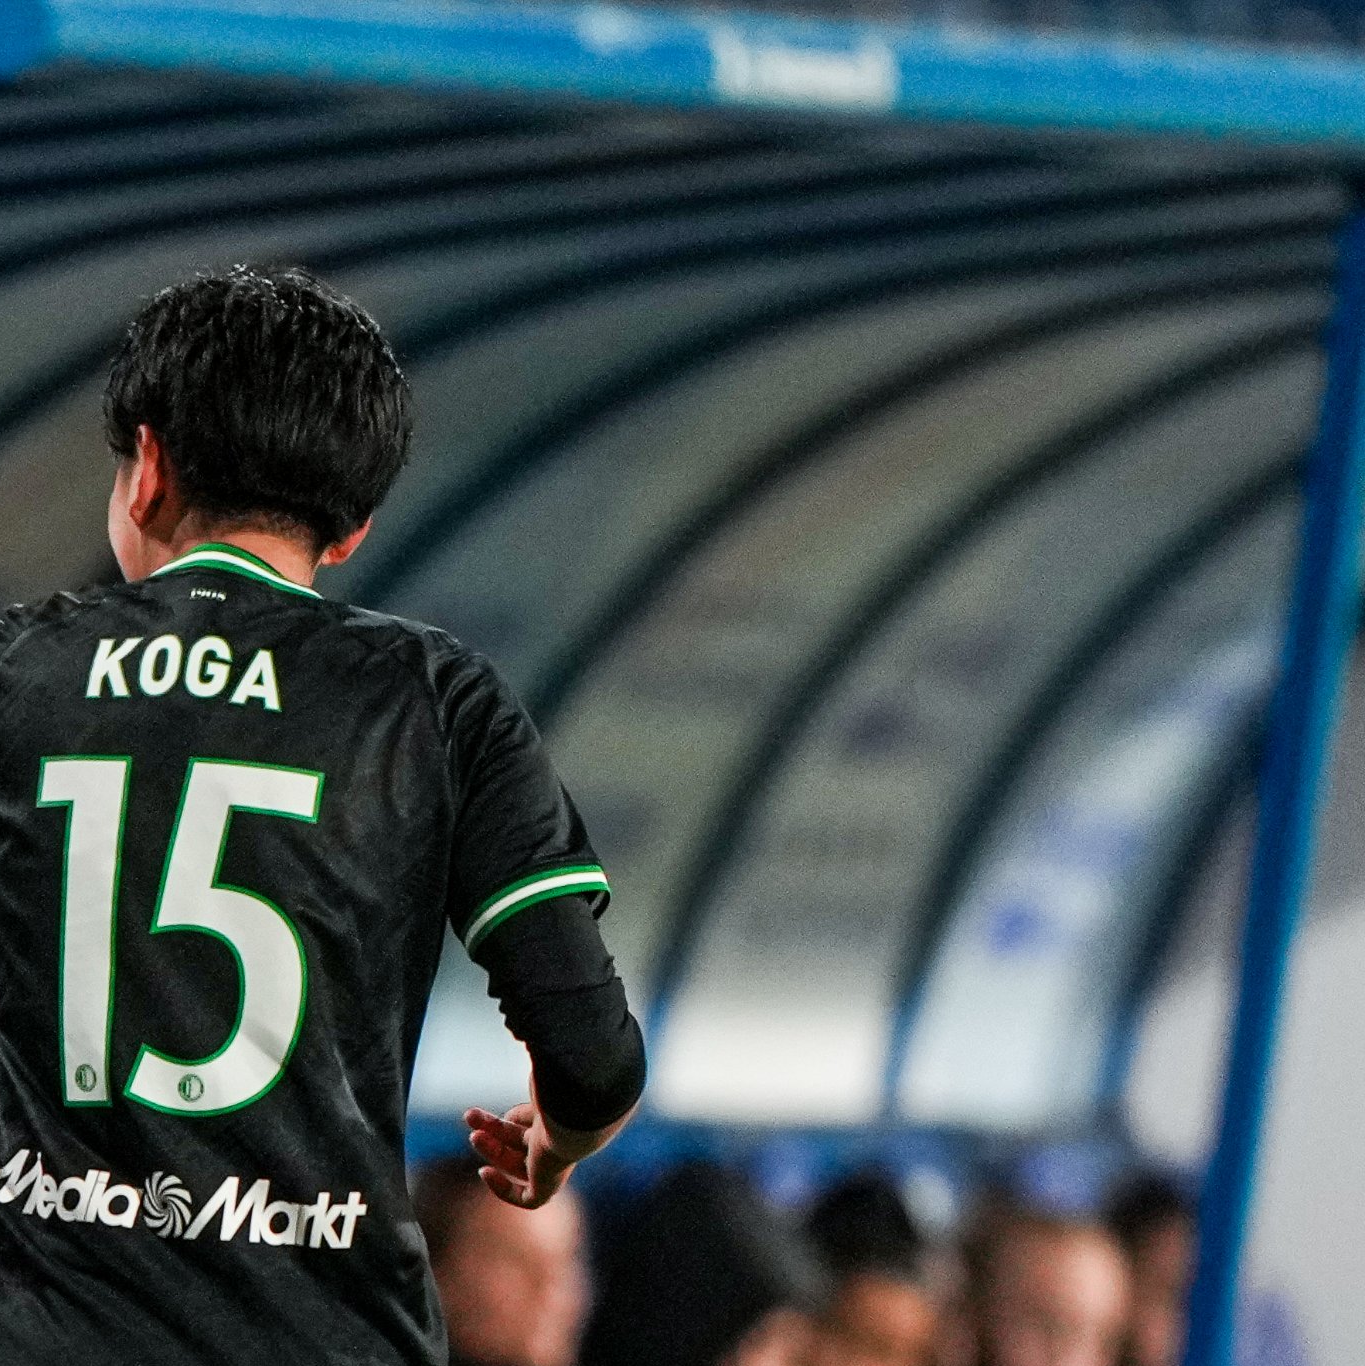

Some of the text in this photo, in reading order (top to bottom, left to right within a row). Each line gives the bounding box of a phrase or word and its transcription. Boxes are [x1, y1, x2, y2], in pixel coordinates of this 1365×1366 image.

[85, 634, 283, 712] KOGA
[36, 755, 325, 1117] 15
[184, 1175, 368, 1250] Markt
